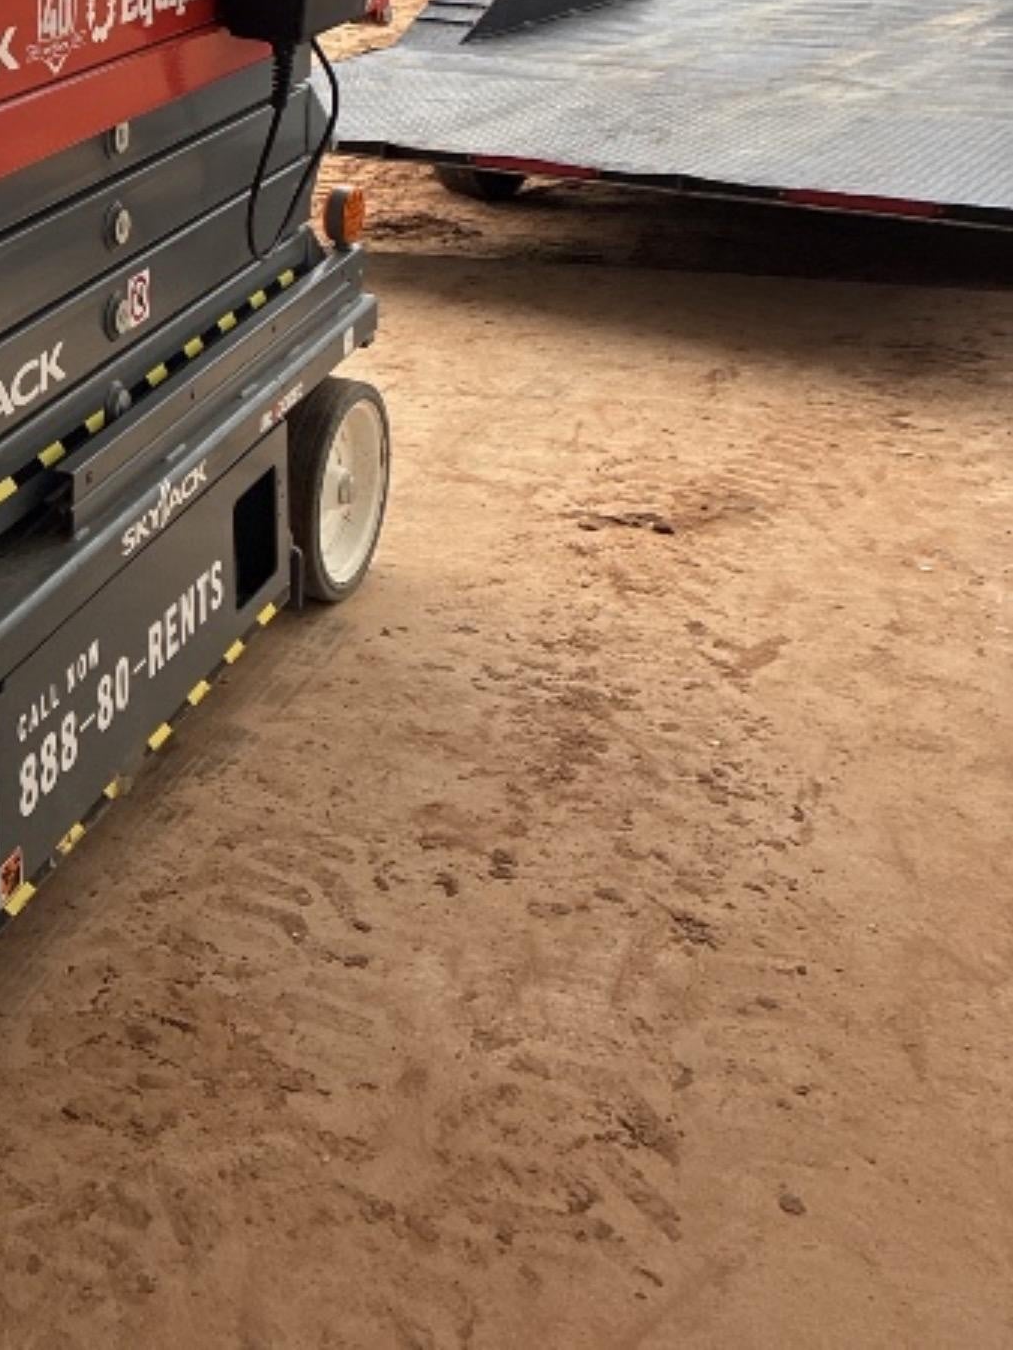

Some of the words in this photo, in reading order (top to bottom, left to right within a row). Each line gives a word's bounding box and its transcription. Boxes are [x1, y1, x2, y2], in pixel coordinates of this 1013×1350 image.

[121, 458, 207, 556] SKYJACK
[17, 683, 60, 743] CALL
[66, 638, 99, 693] NOW
[19, 559, 224, 817] 888-80-RENTS
